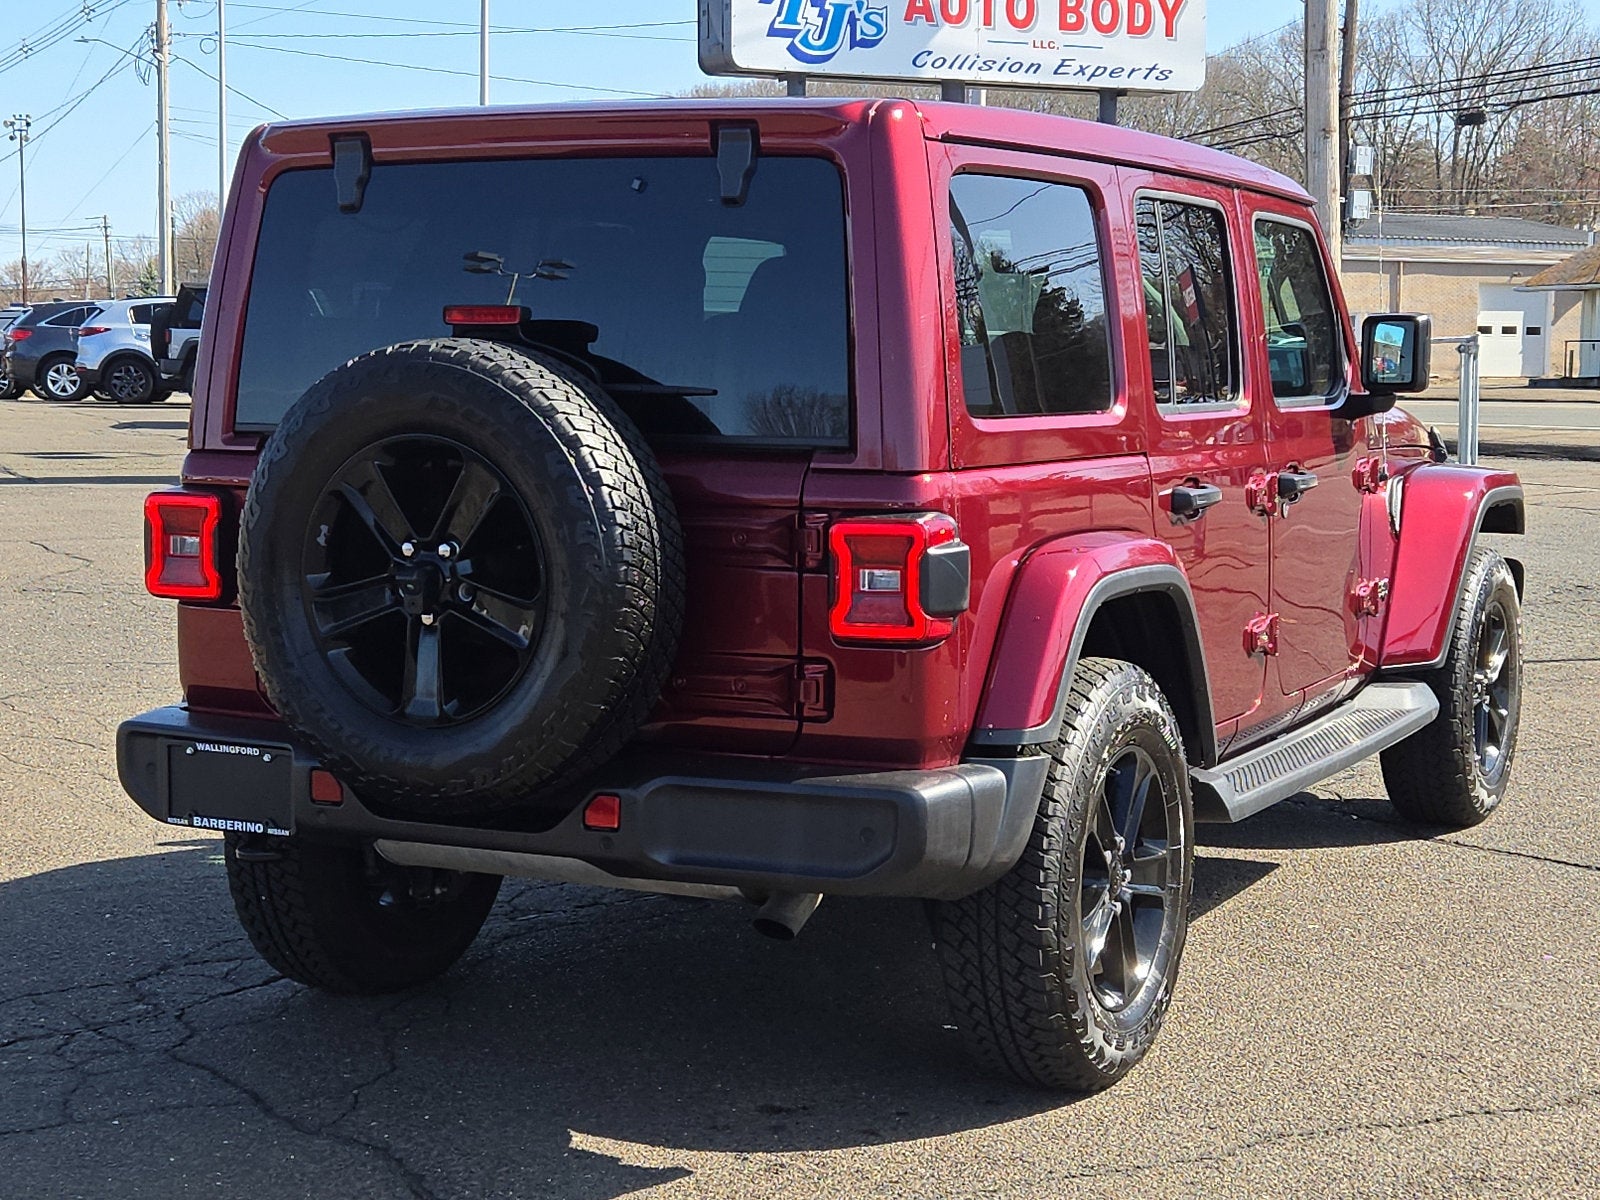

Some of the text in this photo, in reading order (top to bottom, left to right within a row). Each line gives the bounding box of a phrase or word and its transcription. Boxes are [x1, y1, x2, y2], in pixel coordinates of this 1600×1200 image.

[903, 0, 1185, 38] AUTO BODY
[1032, 39, 1060, 51] LLC.
[911, 50, 1174, 82] Collision Experts
[195, 742, 260, 756] WALLINGFORD
[167, 816, 290, 836] NISSAN BARBERINO NISSAN
